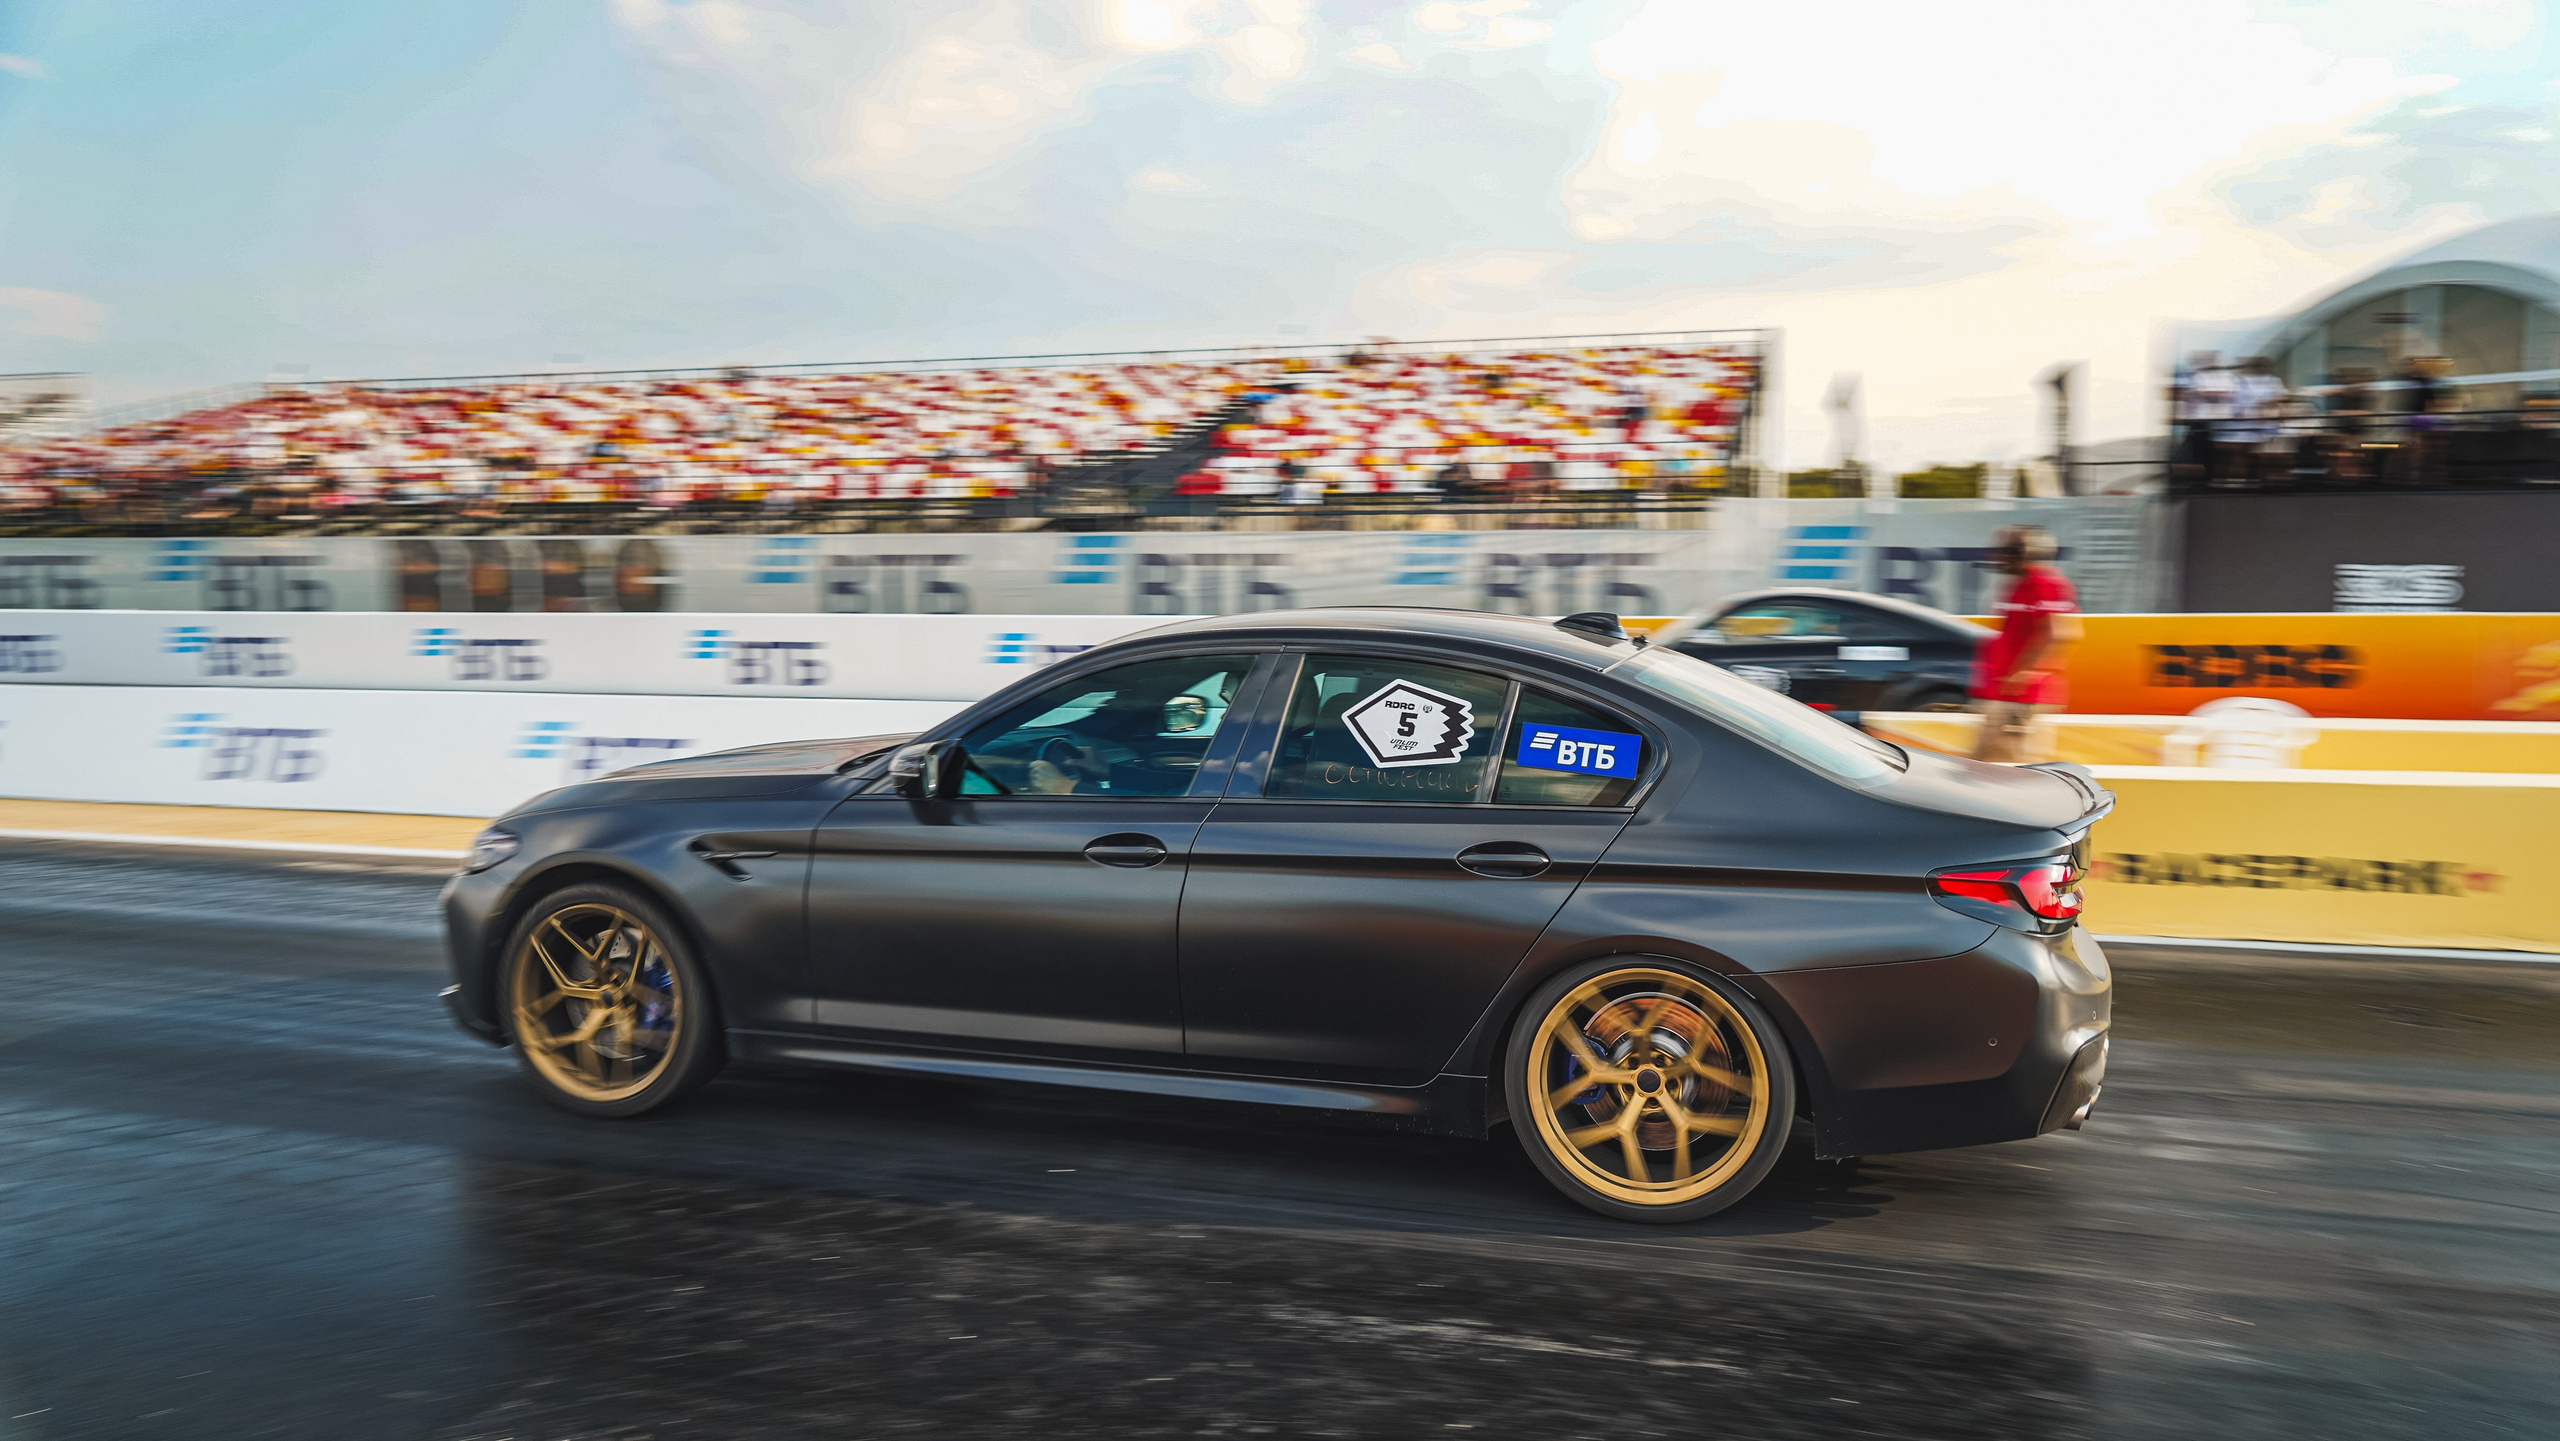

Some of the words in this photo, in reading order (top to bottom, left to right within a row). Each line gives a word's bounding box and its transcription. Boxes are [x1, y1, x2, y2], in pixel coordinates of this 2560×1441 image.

[822, 554, 976, 614] ВТБ
[1130, 553, 1295, 615] ВТБ
[1482, 553, 1665, 616] ВТБ
[1384, 700, 1416, 711] RDRC
[1397, 712, 1418, 737] 5
[1393, 744, 1415, 752] FEST
[1556, 739, 1616, 770] ВТБ
